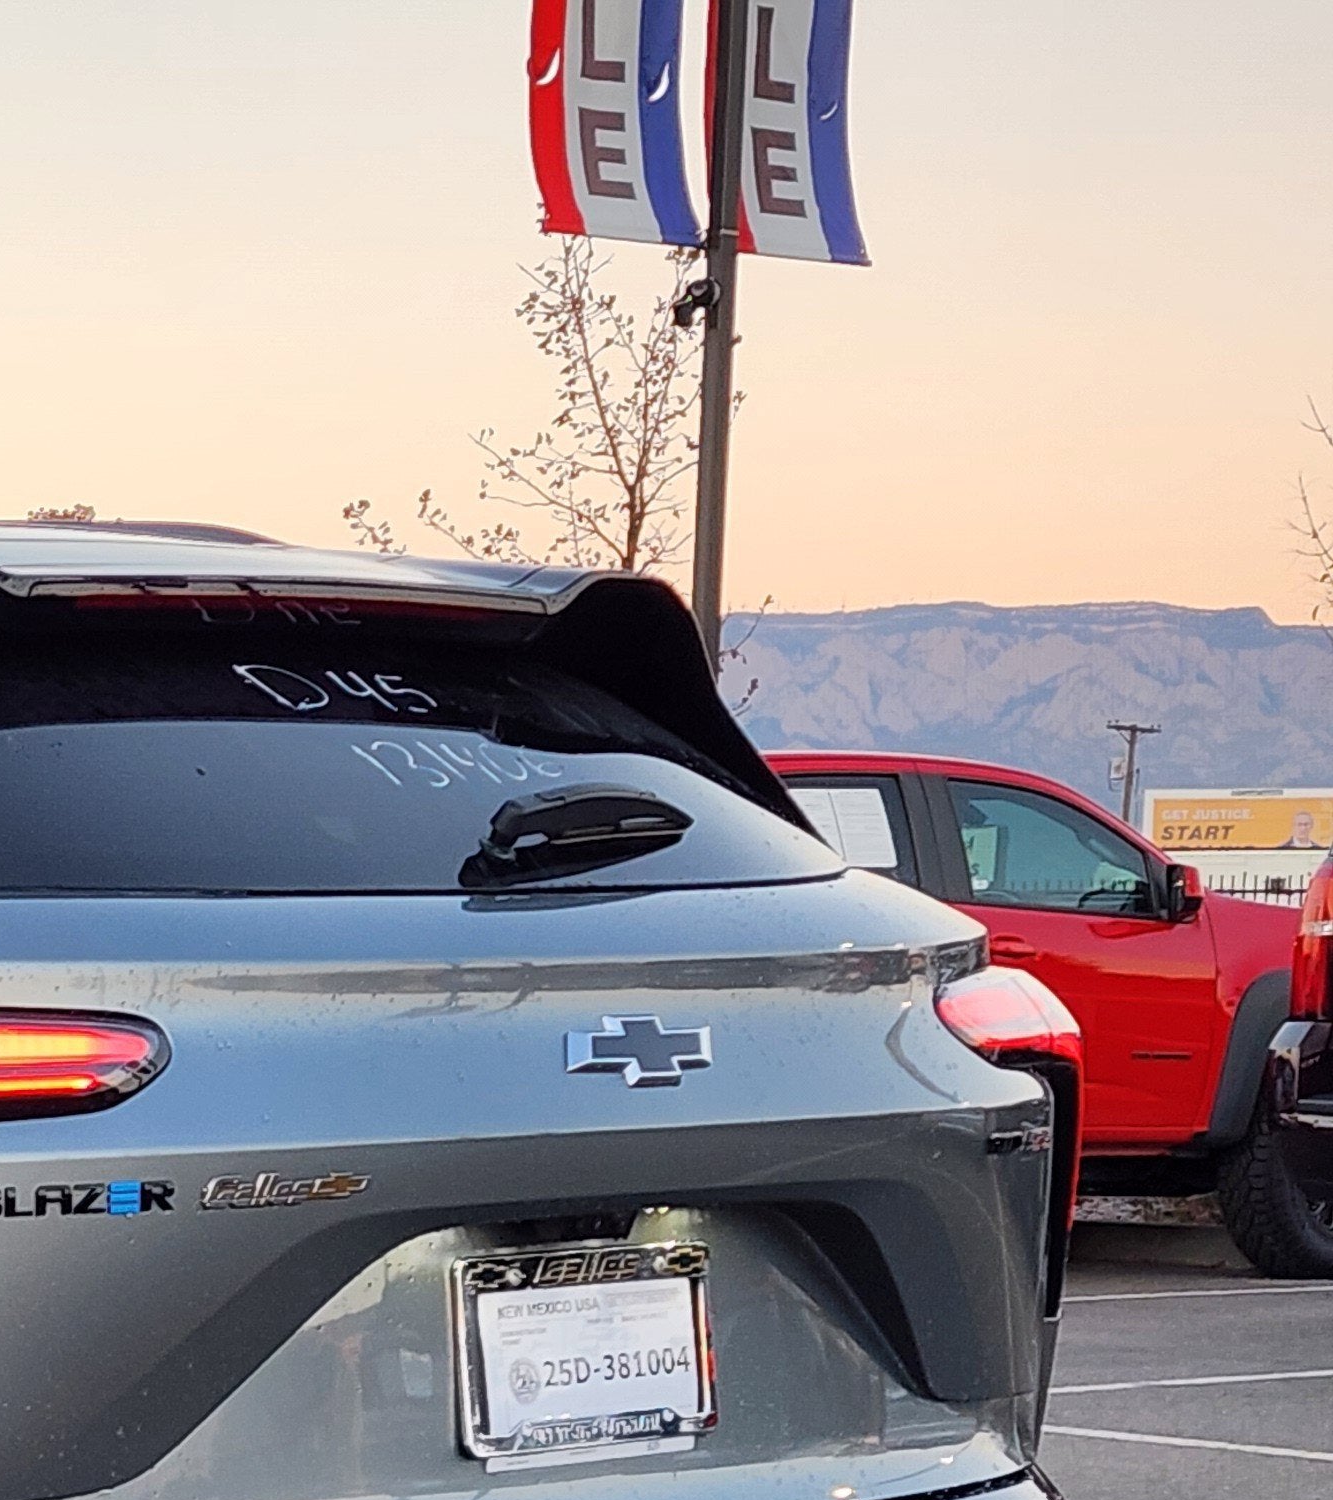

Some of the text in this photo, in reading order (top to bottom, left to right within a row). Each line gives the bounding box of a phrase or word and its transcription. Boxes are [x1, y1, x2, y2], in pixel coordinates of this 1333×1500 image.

[578, 0, 636, 199] LE
[751, 5, 808, 219] LE
[1161, 825, 1235, 841] START
[576, 1297, 601, 1312] USA
[543, 1346, 691, 1388] 25D-381004
